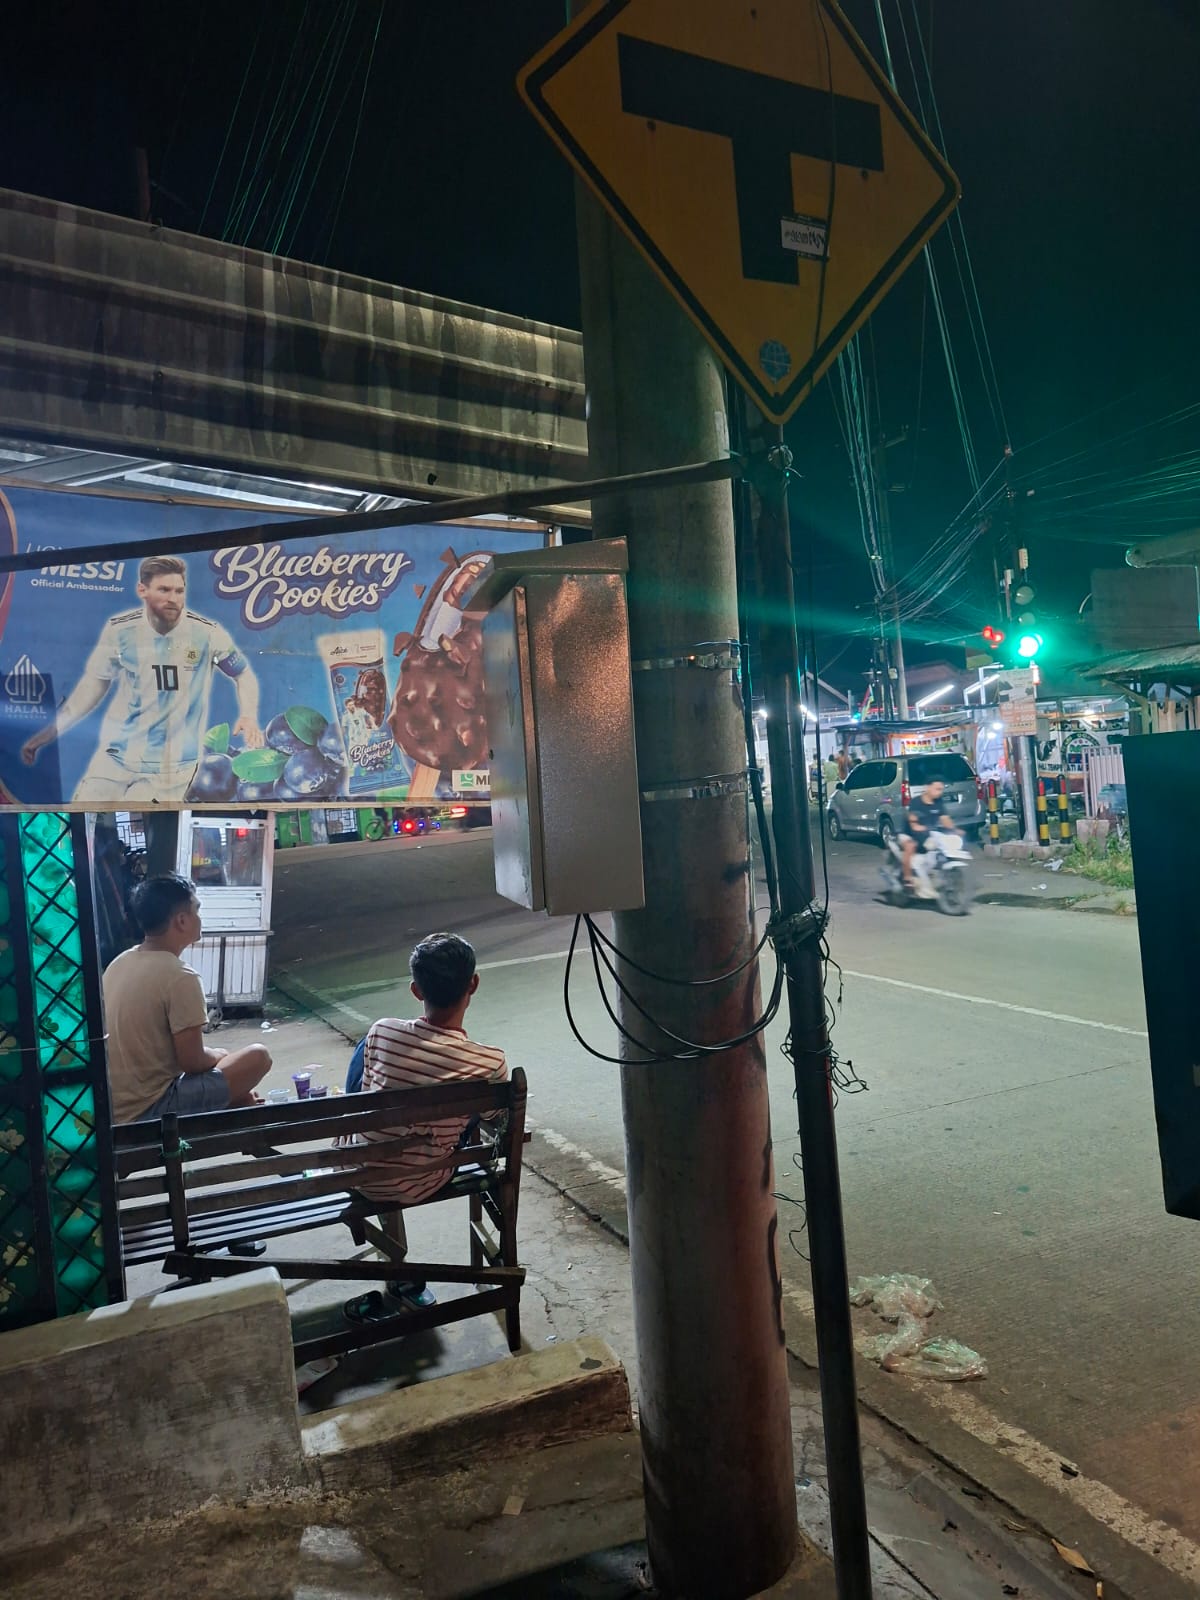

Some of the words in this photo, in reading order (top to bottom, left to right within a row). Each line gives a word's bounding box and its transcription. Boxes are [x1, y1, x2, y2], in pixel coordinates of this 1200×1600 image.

[41, 560, 125, 581] MESSI
[213, 543, 411, 593] Blueberry
[30, 578, 64, 588] Official
[66, 581, 125, 593] Ambassador
[244, 577, 385, 623] Cookies
[151, 664, 179, 691] 10
[4, 704, 47, 714] HALAL
